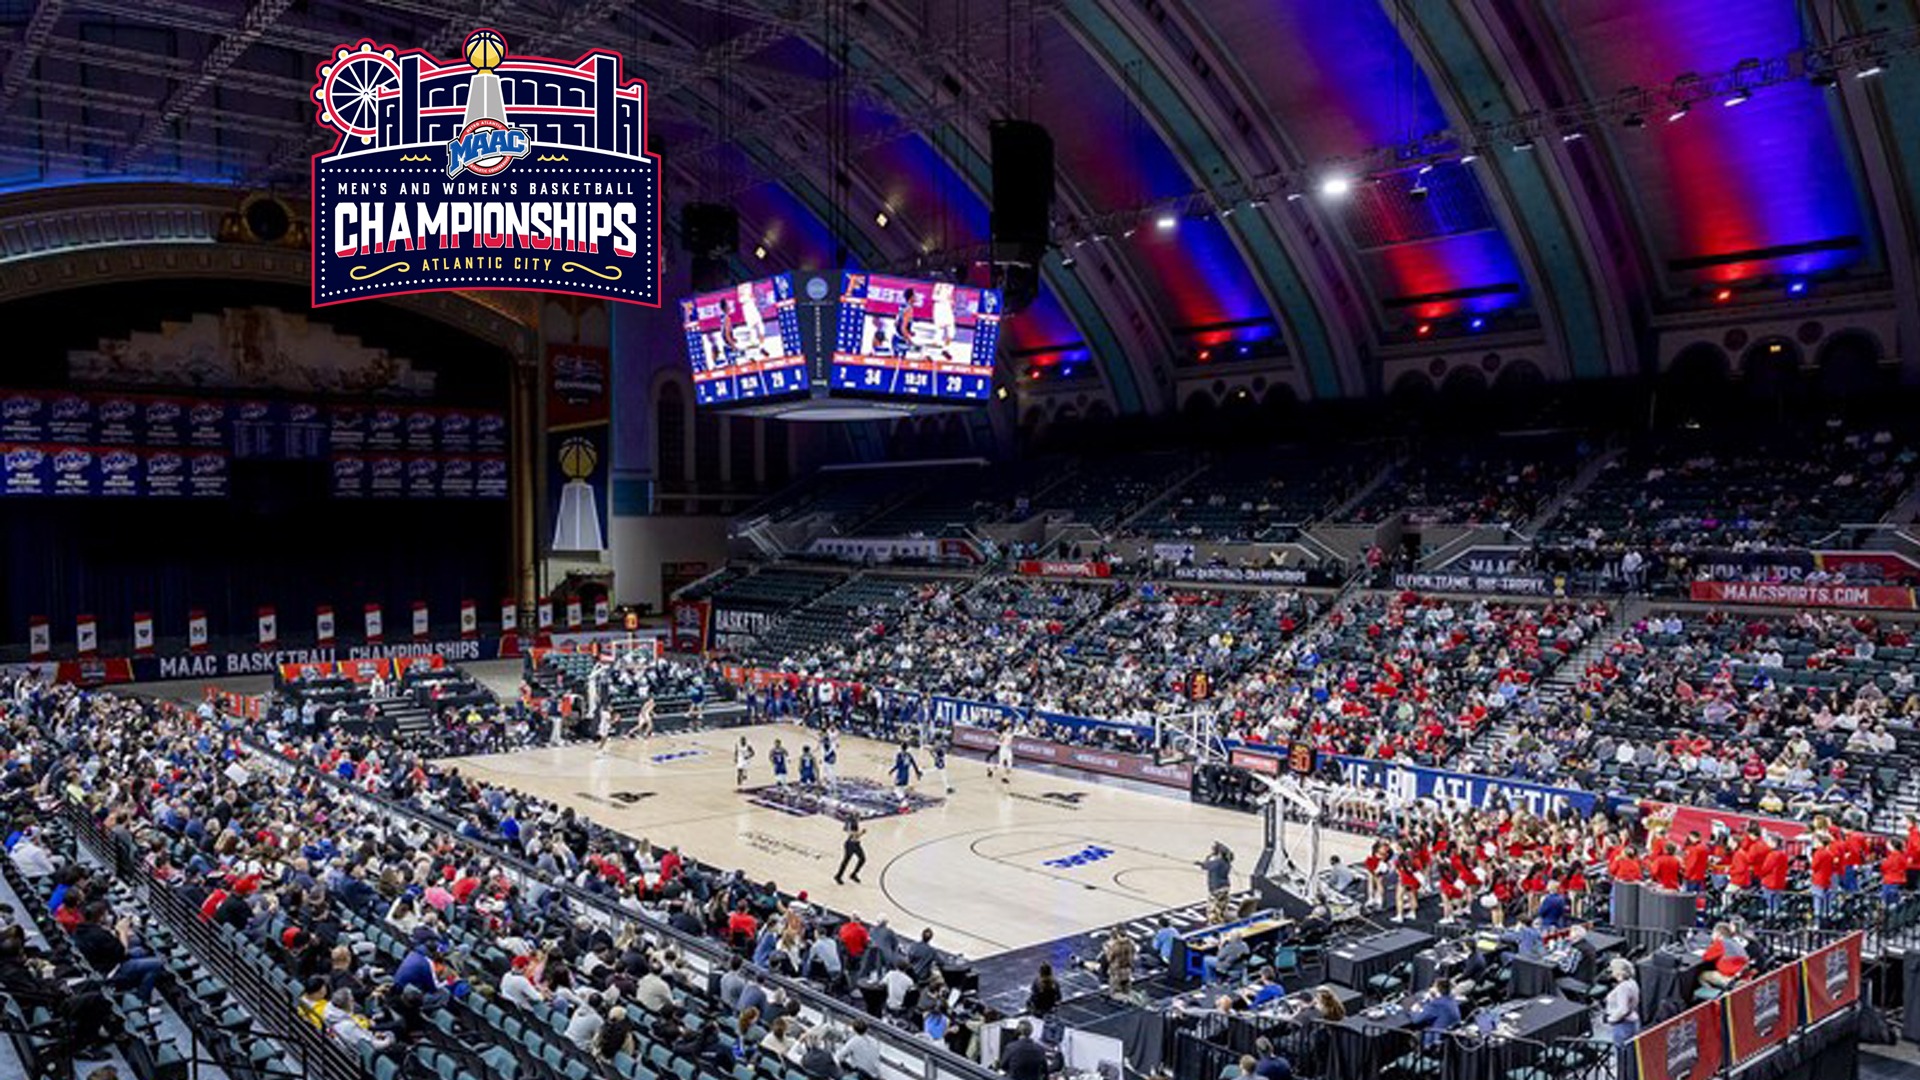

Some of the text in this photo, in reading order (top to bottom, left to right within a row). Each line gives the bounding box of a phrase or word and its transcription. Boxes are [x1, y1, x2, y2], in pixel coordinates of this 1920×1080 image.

[1722, 584, 1869, 604] MAACSPORTS.COM
[160, 655, 217, 678] MAAC
[350, 641, 479, 660] CHAMPIONSHIPS
